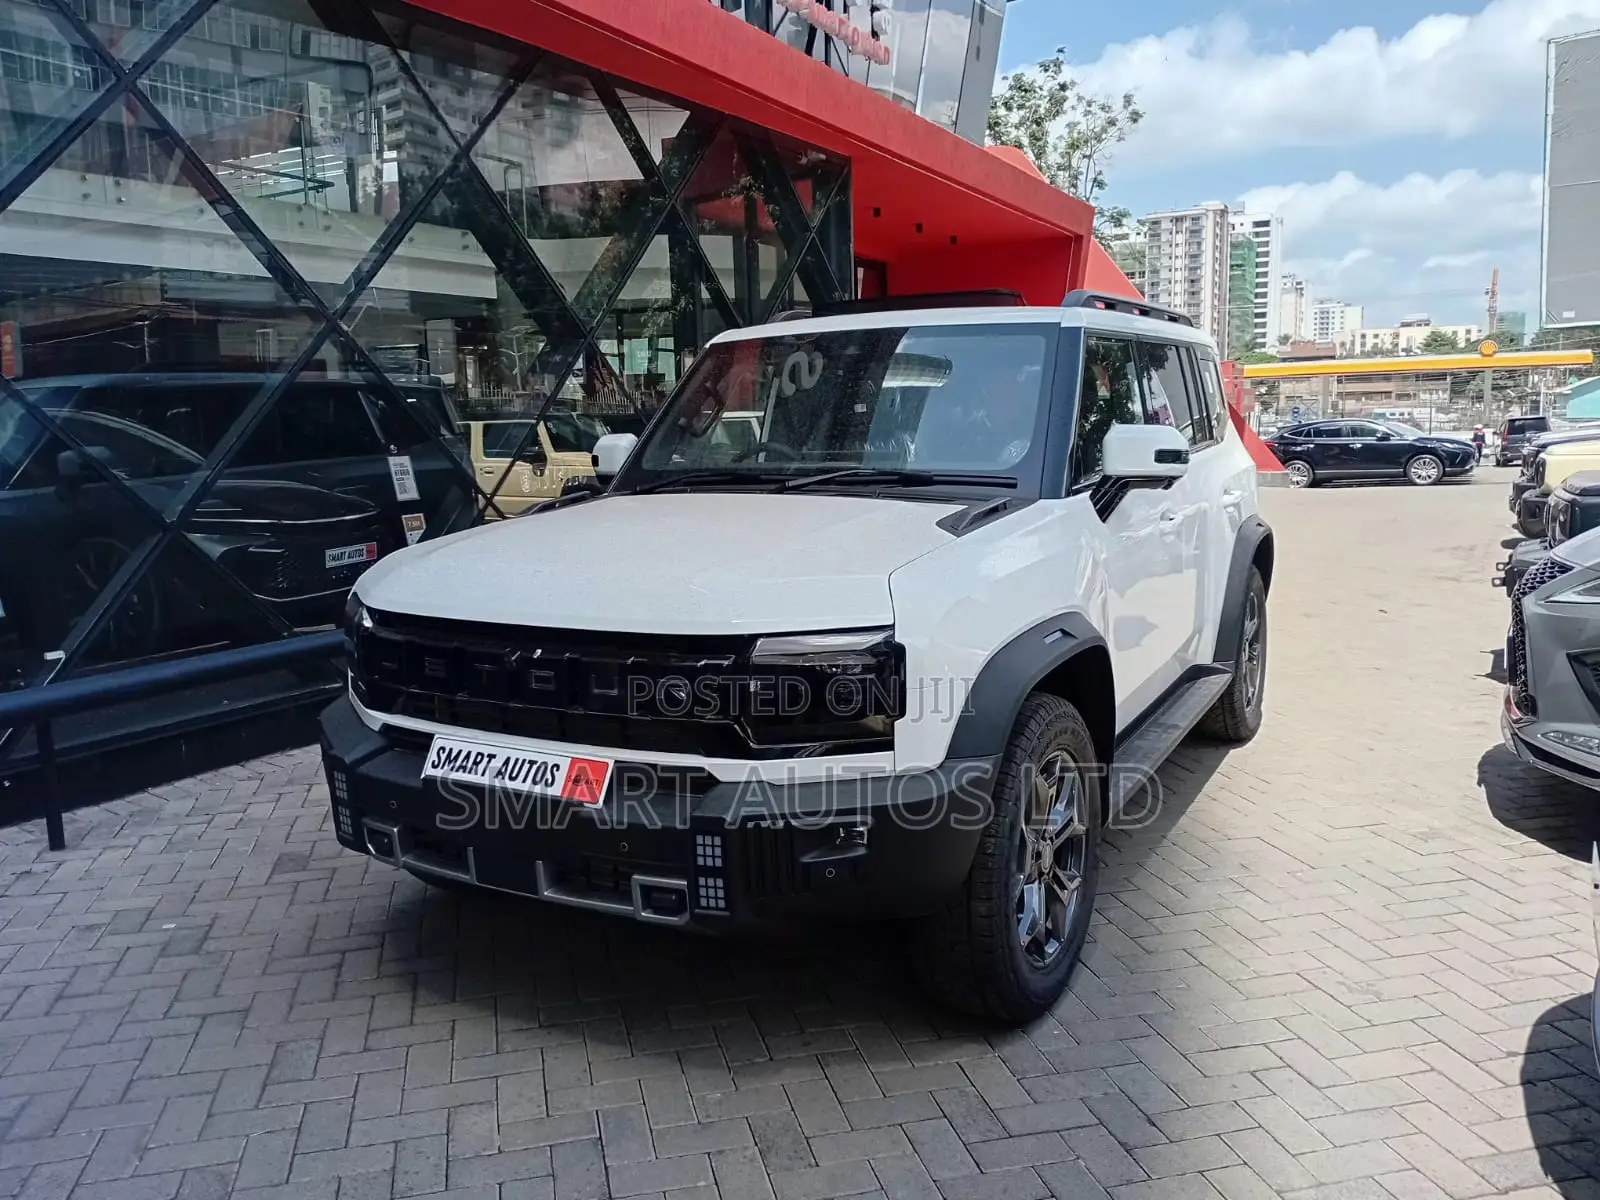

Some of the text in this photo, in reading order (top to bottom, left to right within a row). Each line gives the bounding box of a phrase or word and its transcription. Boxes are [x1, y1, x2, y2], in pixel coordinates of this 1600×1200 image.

[328, 550, 347, 562] SMART
[347, 548, 365, 559] AUTOS
[431, 746, 560, 788] SMART AUTOS
